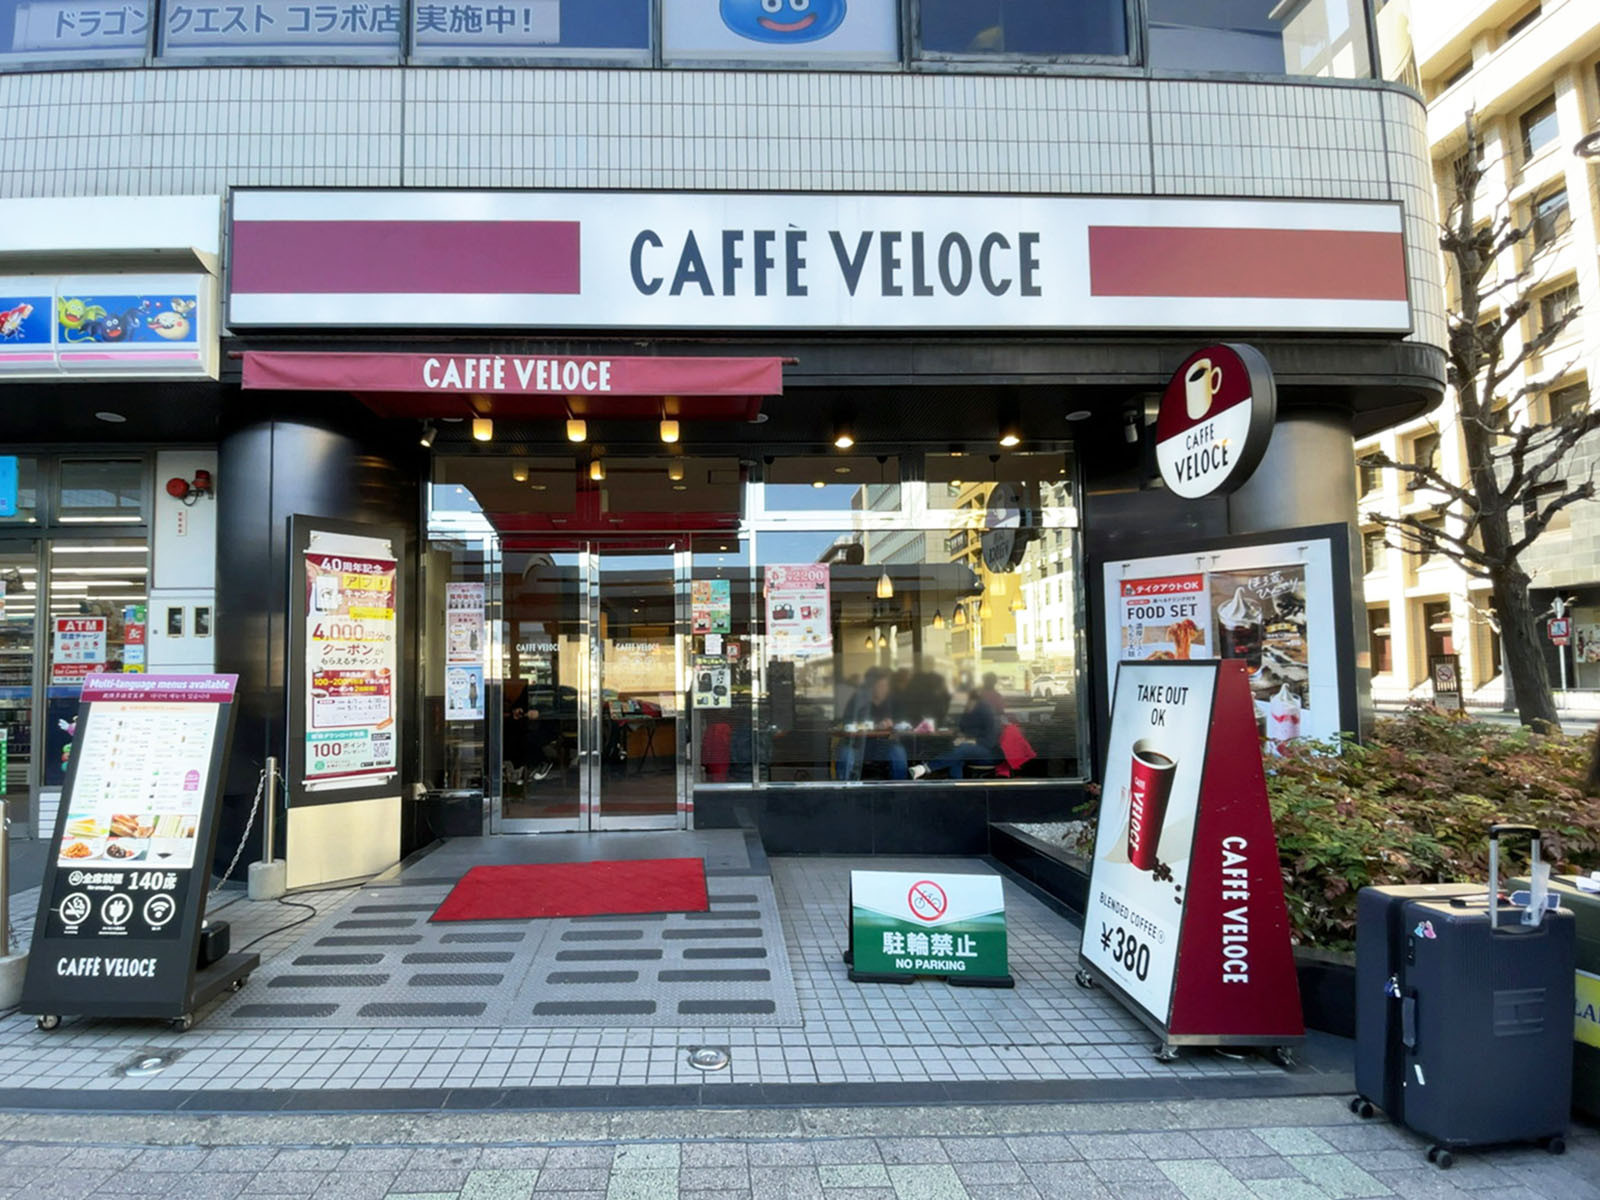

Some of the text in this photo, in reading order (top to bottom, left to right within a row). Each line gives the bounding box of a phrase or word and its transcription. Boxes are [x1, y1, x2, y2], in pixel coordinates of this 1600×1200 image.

[630, 223, 1042, 297] CAFFÈ VELOCE
[513, 359, 611, 391] VELOCE
[1136, 582, 1199, 594] テイクアウトOK
[1127, 603, 1198, 620] FOOD SET
[65, 621, 97, 631] ATM
[89, 678, 157, 691] Multi-language
[157, 680, 186, 690] menus
[188, 679, 231, 690] available
[1137, 684, 1189, 706] TAKE OUT
[1151, 708, 1165, 727] OK
[313, 742, 342, 757] 100
[1129, 792, 1145, 852] VELOCE
[1099, 891, 1129, 920] BLENDED
[882, 931, 978, 957] 駐輪禁止
[1100, 921, 1151, 982] ¥380
[1222, 906, 1248, 983] VELOCE
[105, 958, 157, 977] VELOCE
[895, 958, 966, 971] NO PARKING
